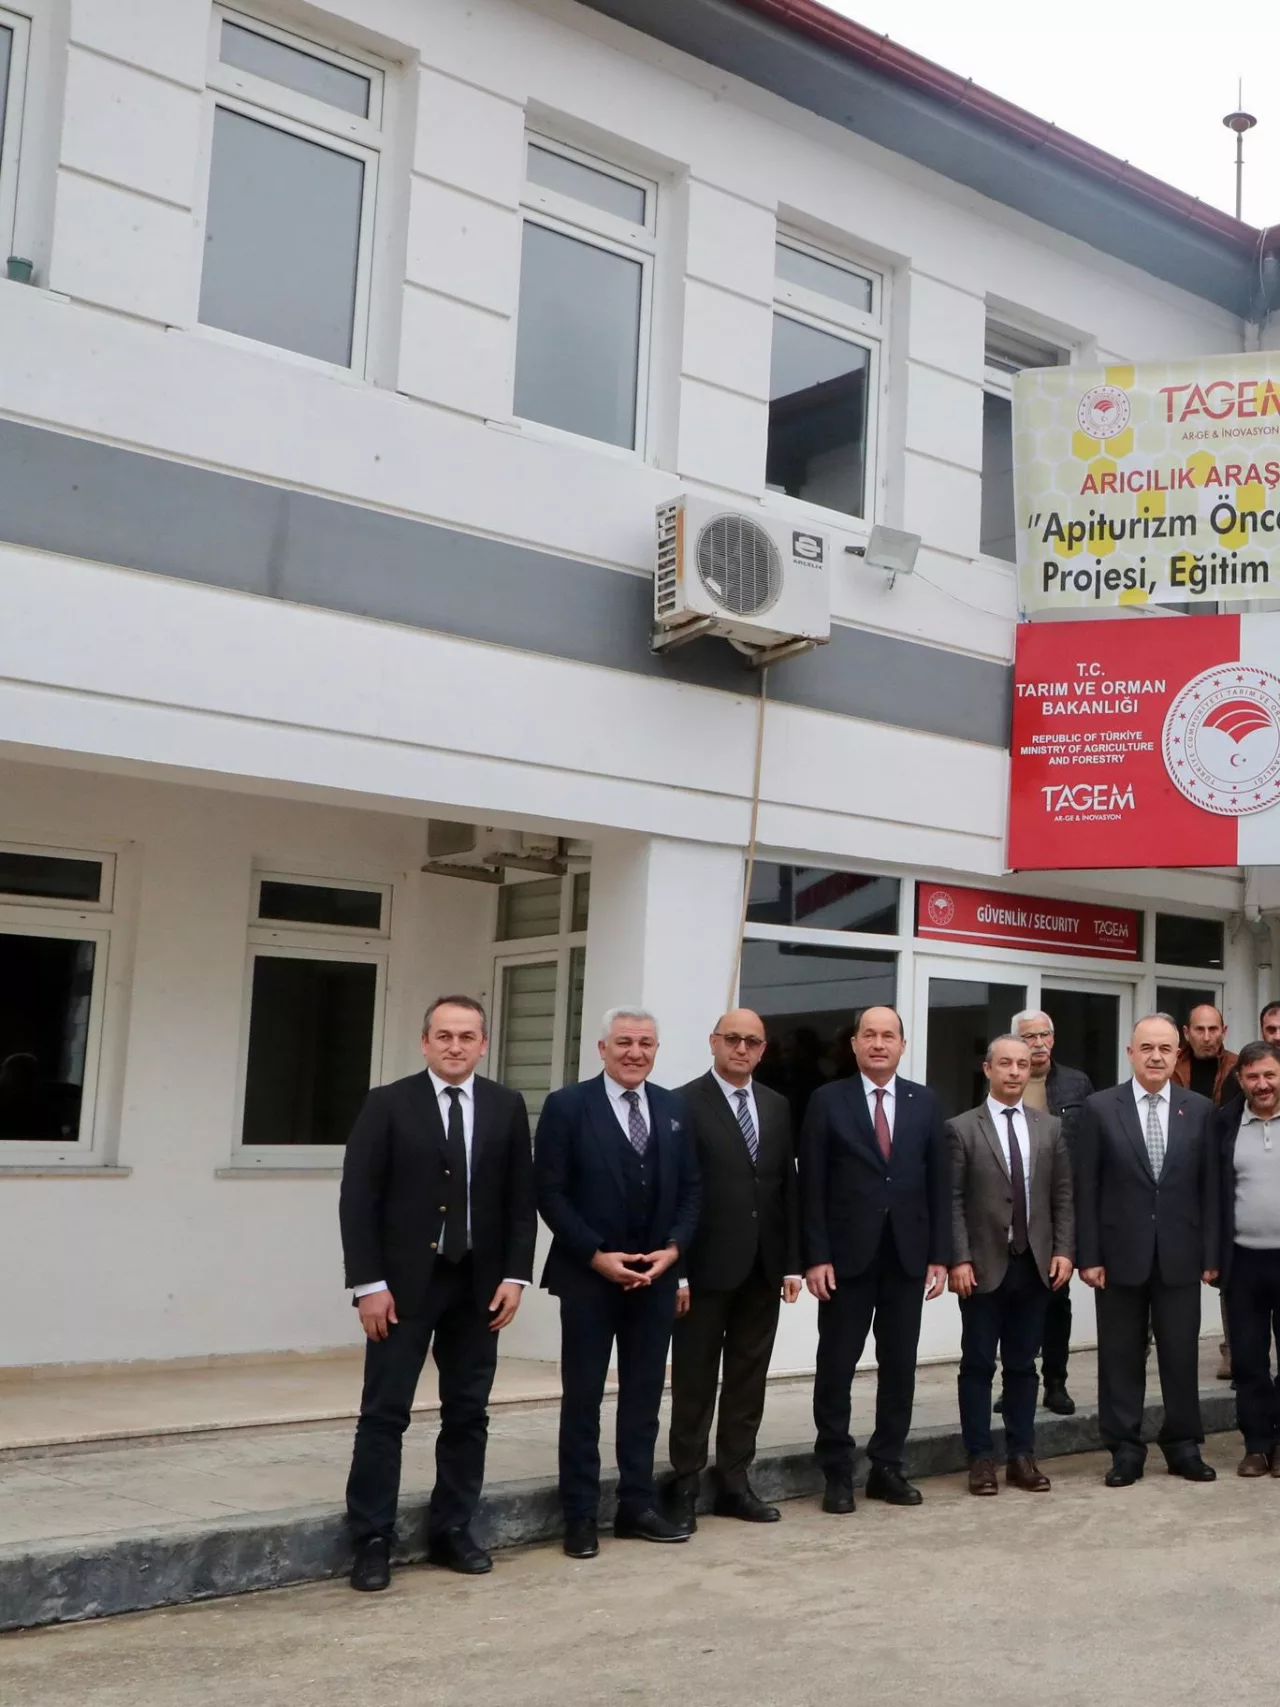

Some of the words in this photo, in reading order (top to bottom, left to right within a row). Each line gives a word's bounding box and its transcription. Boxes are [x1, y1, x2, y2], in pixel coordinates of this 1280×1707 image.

[1182, 429, 1209, 440] AR-GE
[1212, 428, 1219, 439] &
[1222, 426, 1280, 438] İNOVASYON
[1080, 467, 1195, 495] ARICILIK
[1043, 557, 1158, 599] Projesi,
[1170, 552, 1270, 595] Eğitim
[1076, 662, 1106, 677] T.C.
[1016, 682, 1069, 697] TARIM
[1073, 681, 1097, 696] VE
[1101, 679, 1167, 695] ORMAN
[1227, 689, 1256, 697] TARIM
[1259, 694, 1270, 704] VE
[1042, 696, 1139, 716] BAKANLIĞI
[1032, 733, 1082, 744] REPUBLIC
[1083, 732, 1098, 742] OF
[1100, 729, 1143, 741] TÜRKİYE
[1020, 745, 1066, 755] MINISTRY
[1068, 744, 1082, 753] OF
[1083, 742, 1154, 753] AGRICULTURE
[1048, 756, 1070, 766] AND
[1072, 754, 1126, 765] FORESTRY
[1041, 783, 1135, 812] TAGEM
[976, 904, 1027, 928] GÜVENLİK
[1034, 914, 1080, 934] SECURITY
[1093, 920, 1129, 938] TAGEM
